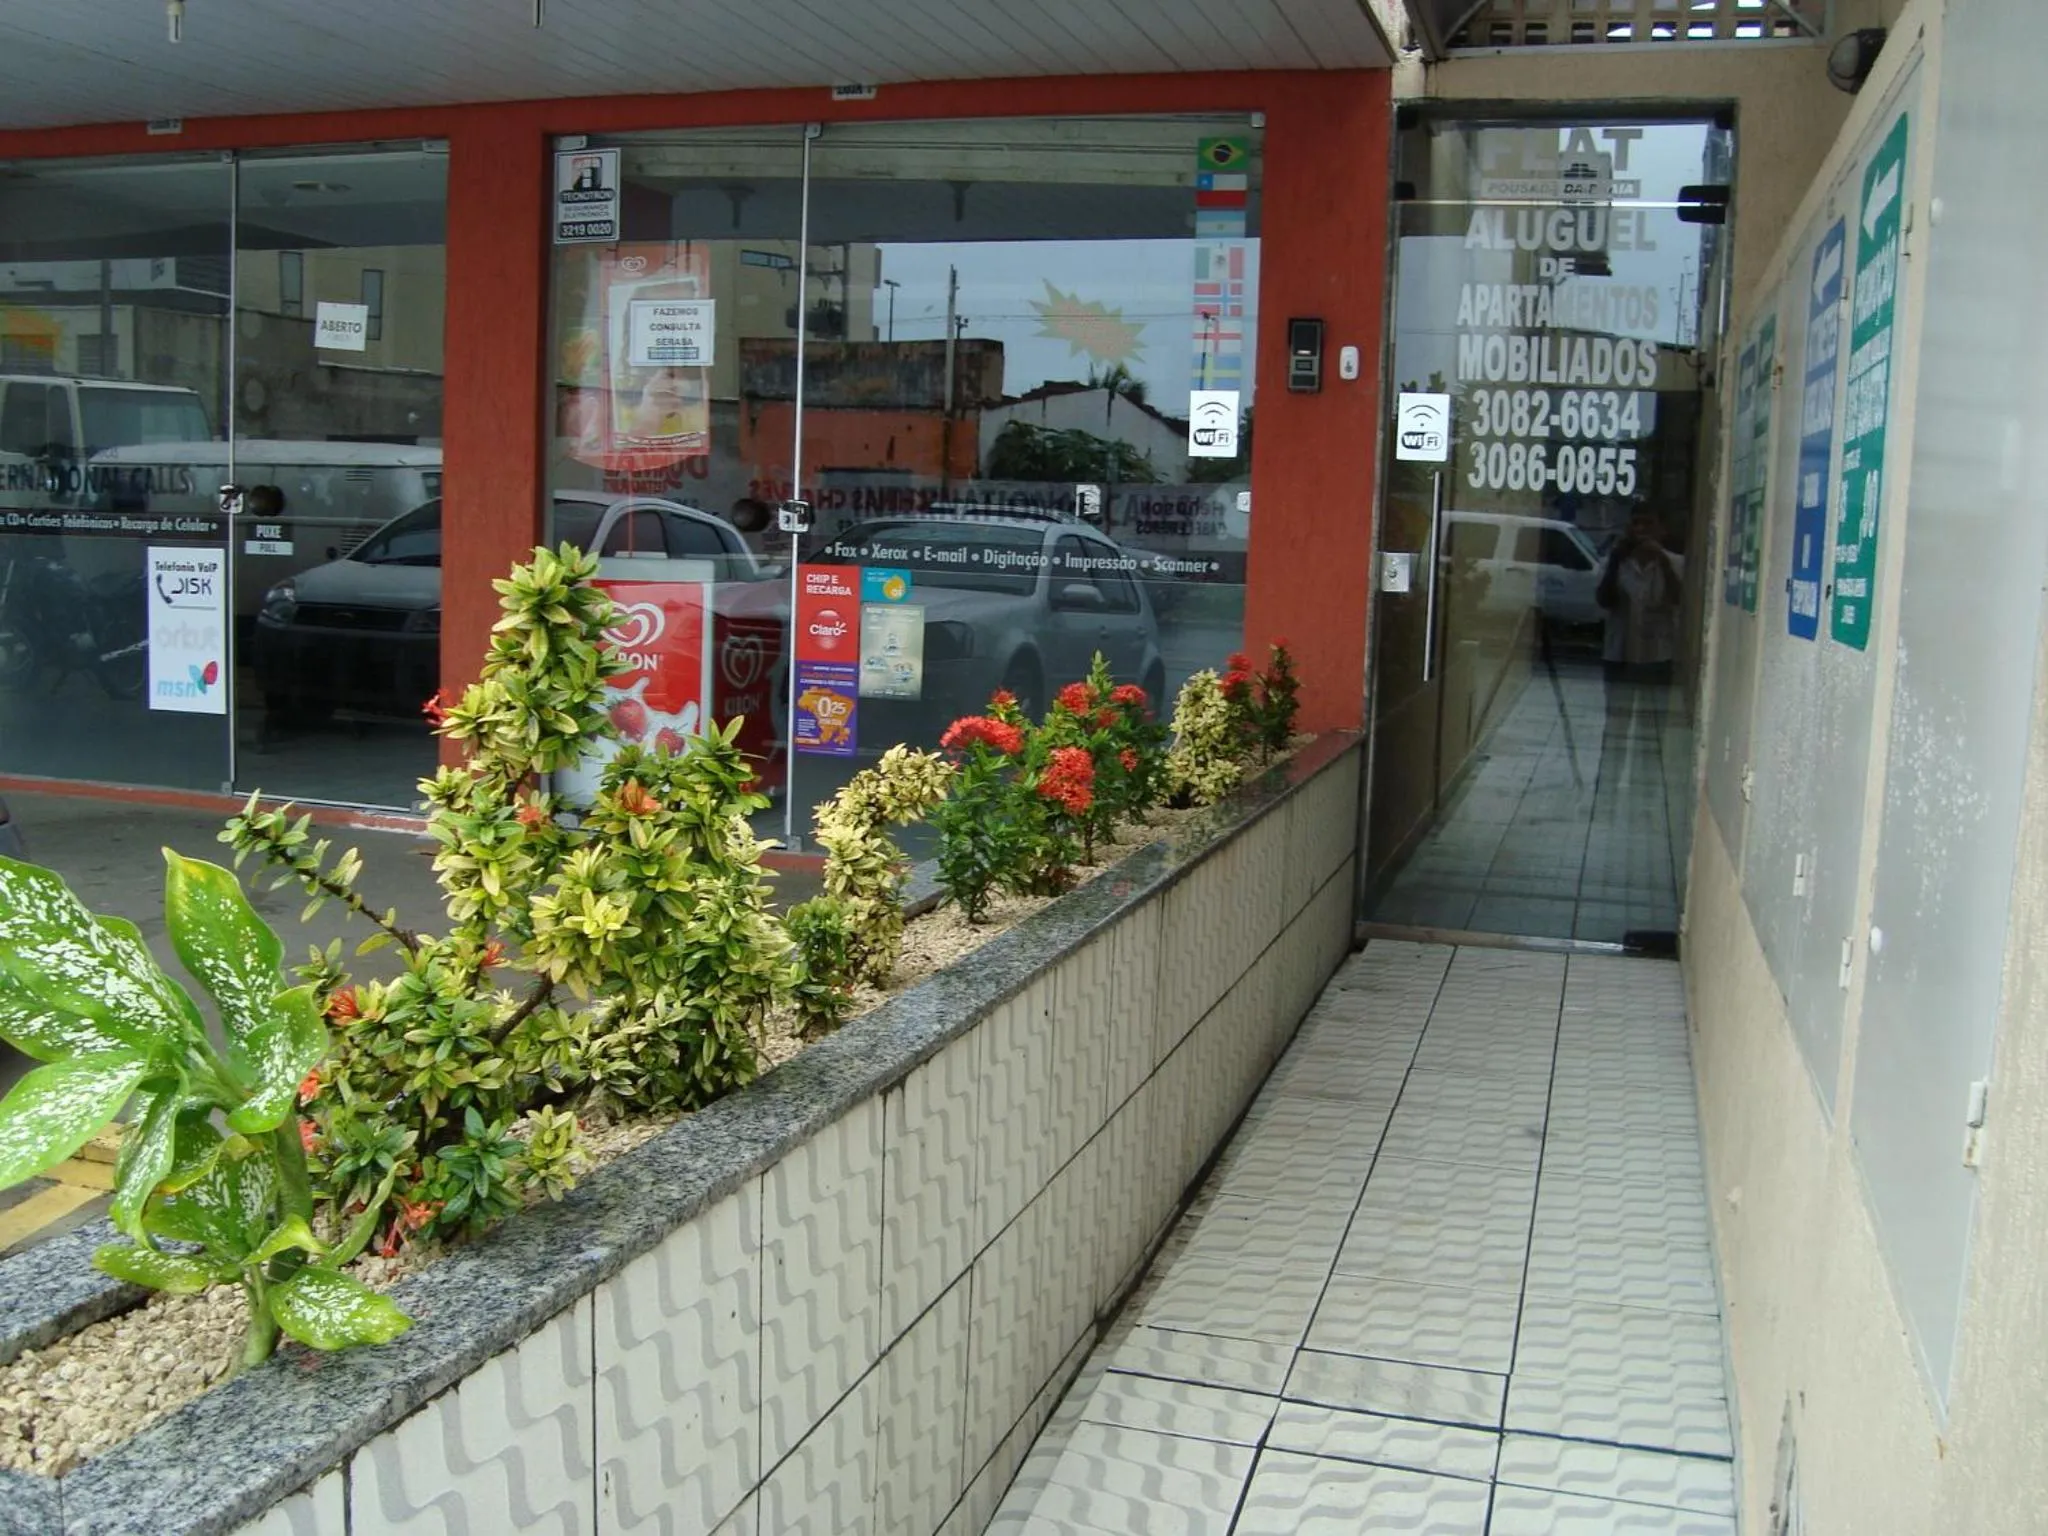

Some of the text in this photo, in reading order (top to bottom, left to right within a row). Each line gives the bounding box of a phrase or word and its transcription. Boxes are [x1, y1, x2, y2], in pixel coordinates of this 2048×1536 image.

[1482, 128, 1644, 171] FLAT
[1464, 210, 1656, 251] ALUGUEL
[1539, 257, 1577, 277] DE
[653, 307, 700, 316] FAZEMOS
[1457, 283, 1659, 331] APARTAMENTOS
[320, 319, 362, 334] ABERTO
[649, 322, 702, 331] CONSULTA
[655, 338, 694, 346] SERASA
[1457, 333, 1658, 387] MOBILIADOS
[1470, 389, 1641, 439] 3082-6634
[1466, 441, 1637, 496] 3086-0855
[154, 560, 196, 573] Telefonia
[835, 542, 1208, 574] Fax Xerox E-mail Digitação Impressão Scanner
[806, 573, 840, 585] CHIP E
[806, 585, 853, 597] RECARGA
[809, 622, 842, 637] Claro
[156, 680, 197, 698] msn
